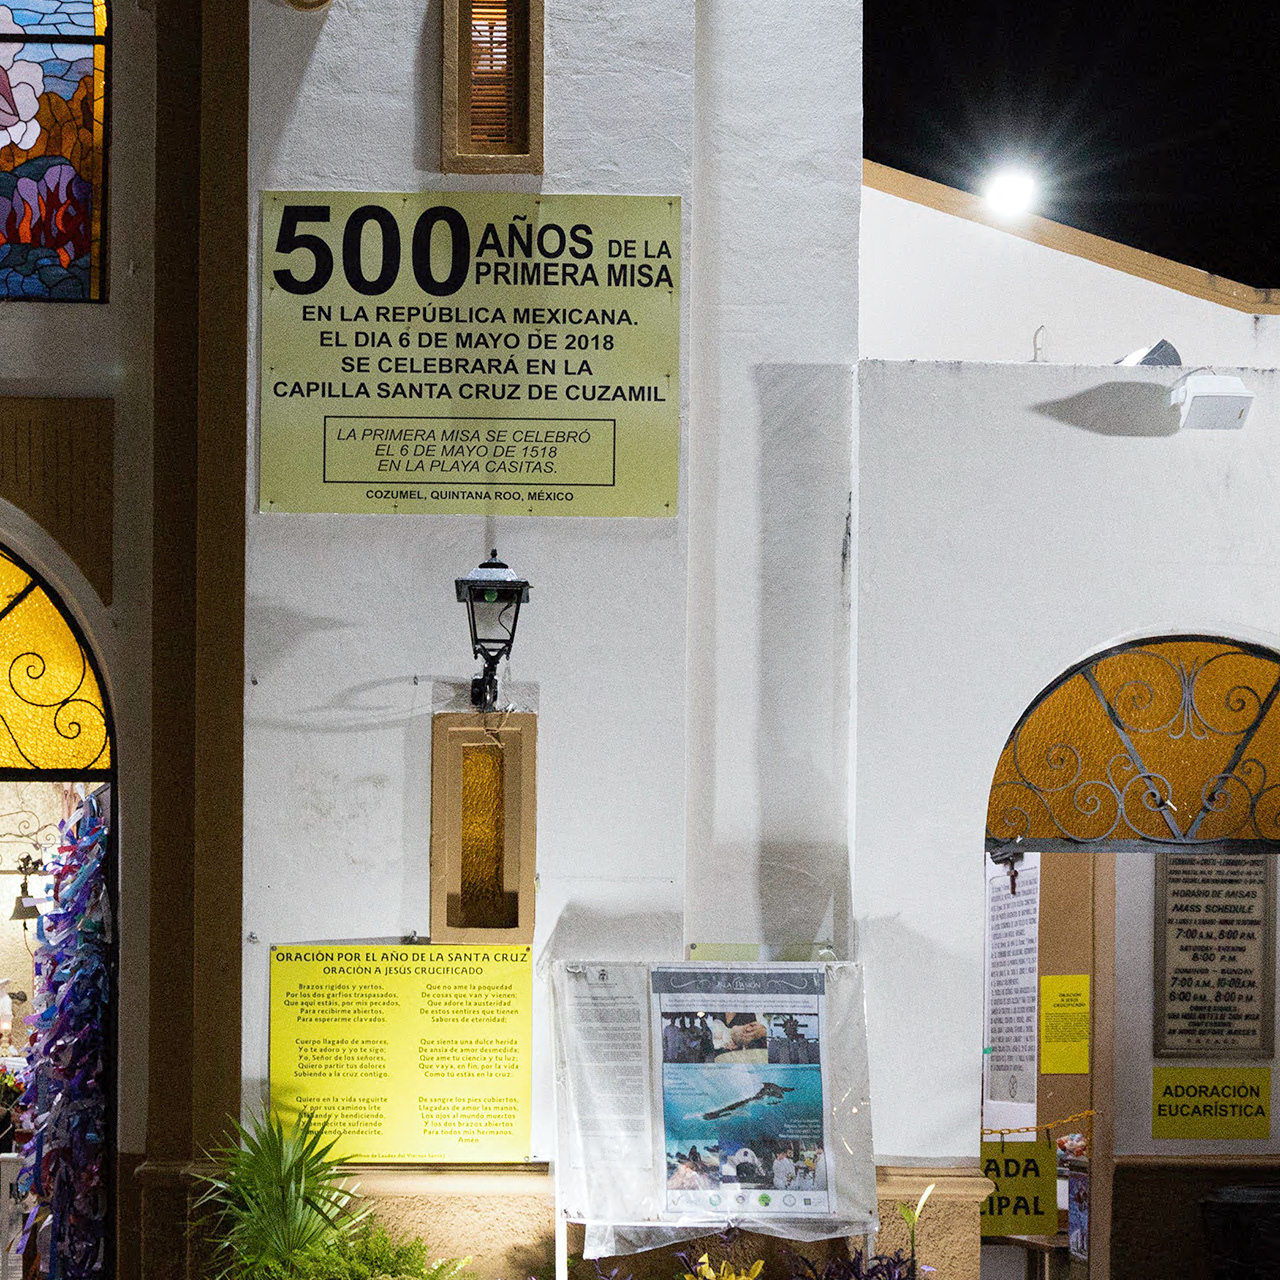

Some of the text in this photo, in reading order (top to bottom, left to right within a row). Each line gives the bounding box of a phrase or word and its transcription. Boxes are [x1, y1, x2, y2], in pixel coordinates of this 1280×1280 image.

[273, 205, 671, 296] 500 AÑOS DE LA
[476, 262, 673, 287] PRIMERA MISA
[303, 302, 637, 325] EN LA REPÚBLICA MEXICANA.
[320, 331, 614, 350] EL DIA 6 DE MAYO DE 2018
[342, 353, 592, 375] SE CELEBRARÁ EN LA
[273, 381, 665, 401] CAPILLA SANTA CRUZ DE CUZAMIL
[337, 428, 590, 443] LA PRIMERA MISA SE CELEBRÓ
[375, 444, 557, 458] EL 6 DE MAYO DE 1518
[378, 459, 557, 474] EN LA PLAYA CASITAS.
[366, 488, 574, 502] COZUMEL, QUINTANA ROO, MÉXICO
[1172, 890, 1210, 898] HORARIO
[1211, 890, 1222, 898] DE
[1172, 904, 1253, 913] MASS SCHEDULE
[276, 950, 527, 962] ORACIÓN POR EL AÑO DE LA SANTA CRUZ
[323, 965, 371, 974] ORACIÓN
[385, 967, 411, 976] JESÚS
[1162, 1082, 1260, 1100] ADORACIÓN
[1157, 1099, 1266, 1119] EUCARÍSTICA
